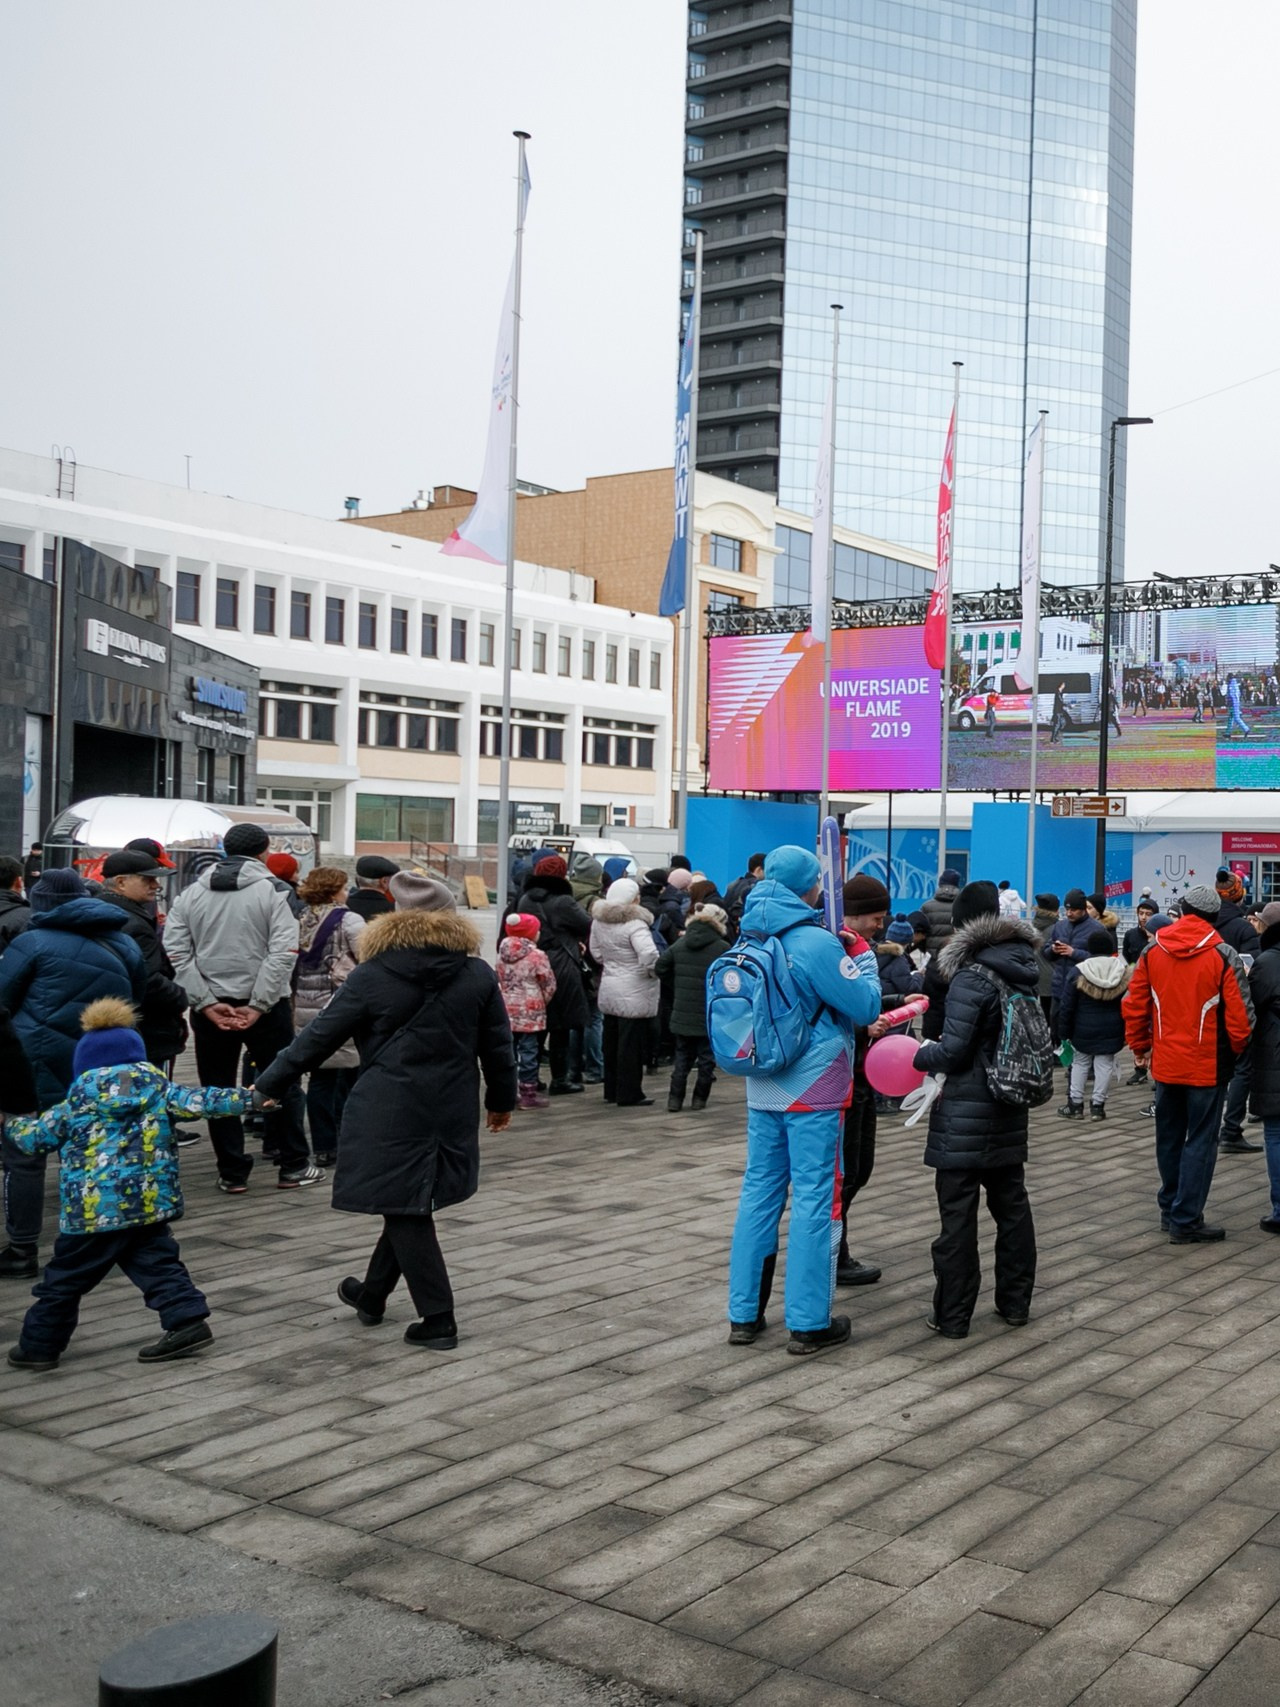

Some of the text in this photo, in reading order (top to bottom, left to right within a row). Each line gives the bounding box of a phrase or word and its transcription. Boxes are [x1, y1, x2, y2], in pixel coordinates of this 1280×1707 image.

[194, 676, 248, 714] SAMSUNG
[845, 700, 902, 718] FLAME
[870, 721, 912, 739] 2019
